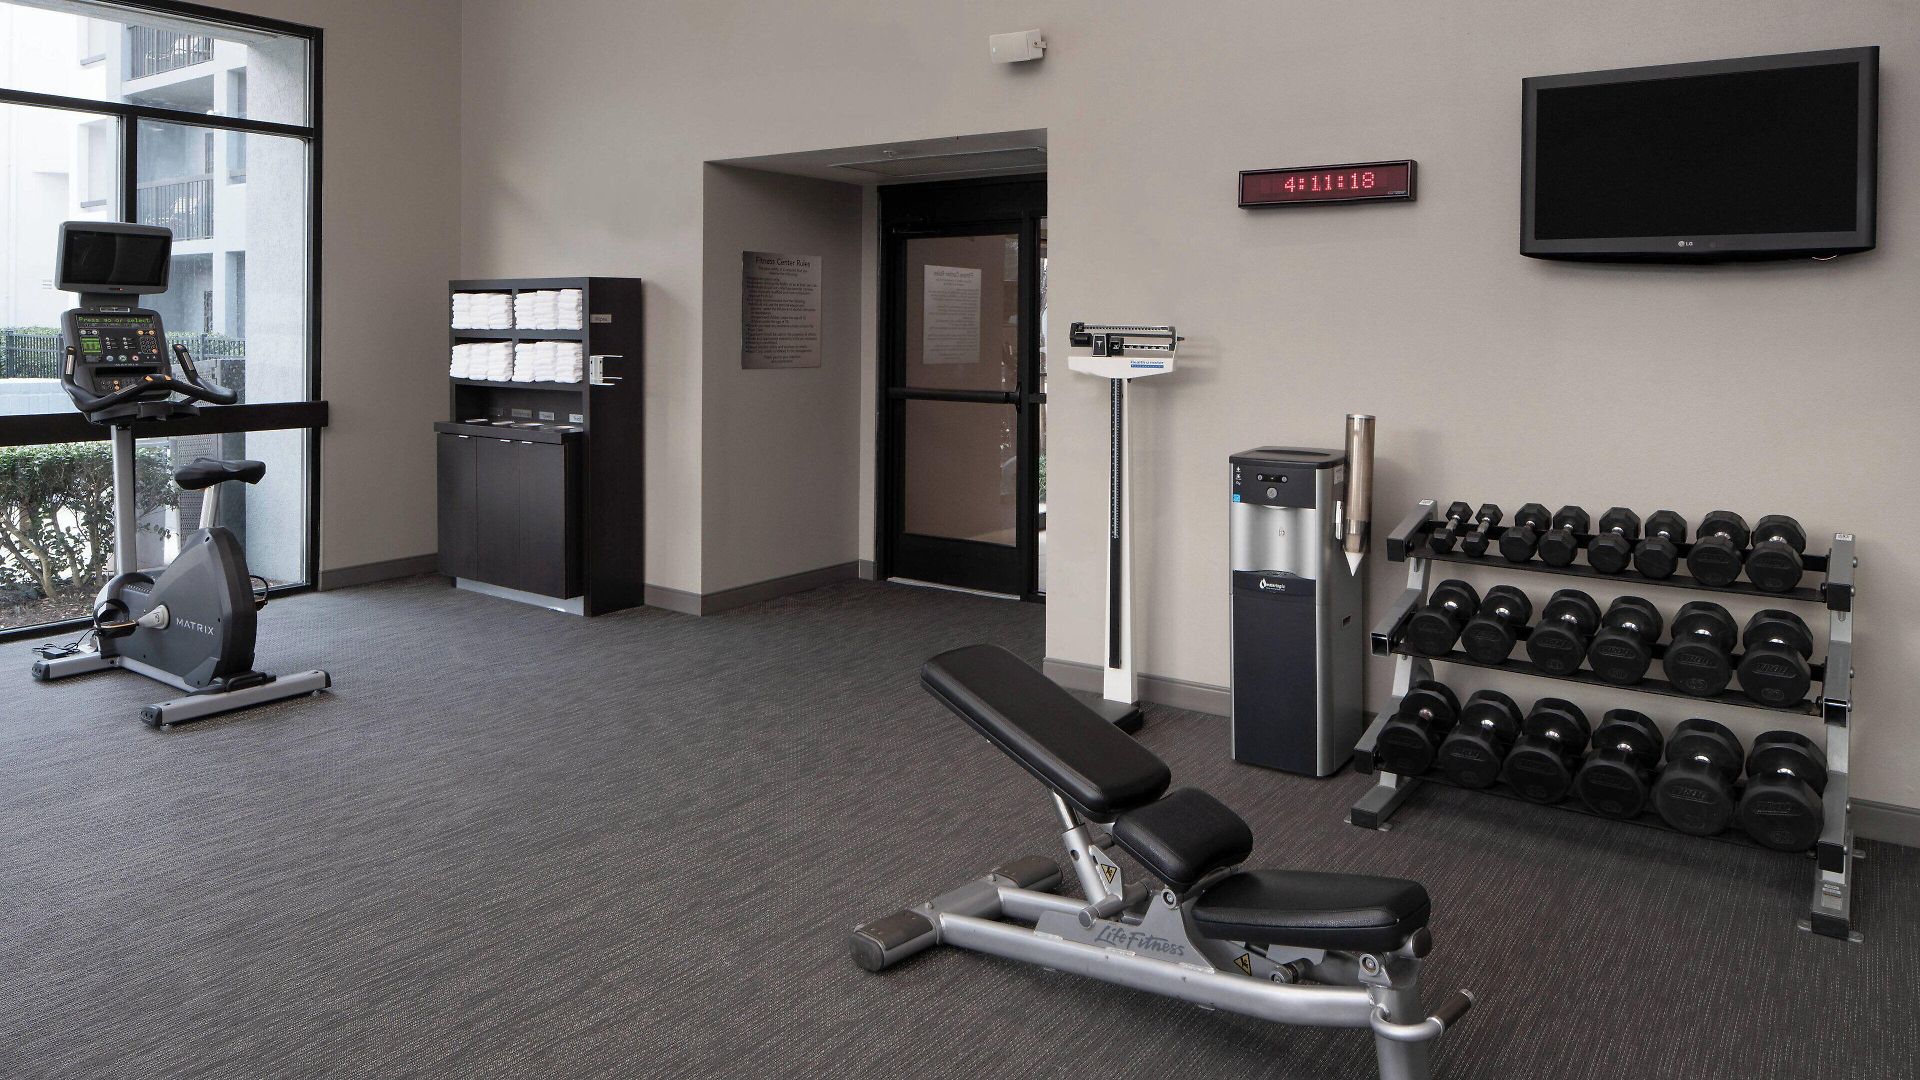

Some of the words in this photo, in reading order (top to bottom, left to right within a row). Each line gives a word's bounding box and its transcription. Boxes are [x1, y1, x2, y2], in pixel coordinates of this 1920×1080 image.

[1284, 172, 1375, 192] 4:11:18
[755, 256, 775, 265] Fitness
[776, 258, 795, 267] Center
[796, 260, 810, 268] Rules
[176, 617, 214, 635] MATRIX
